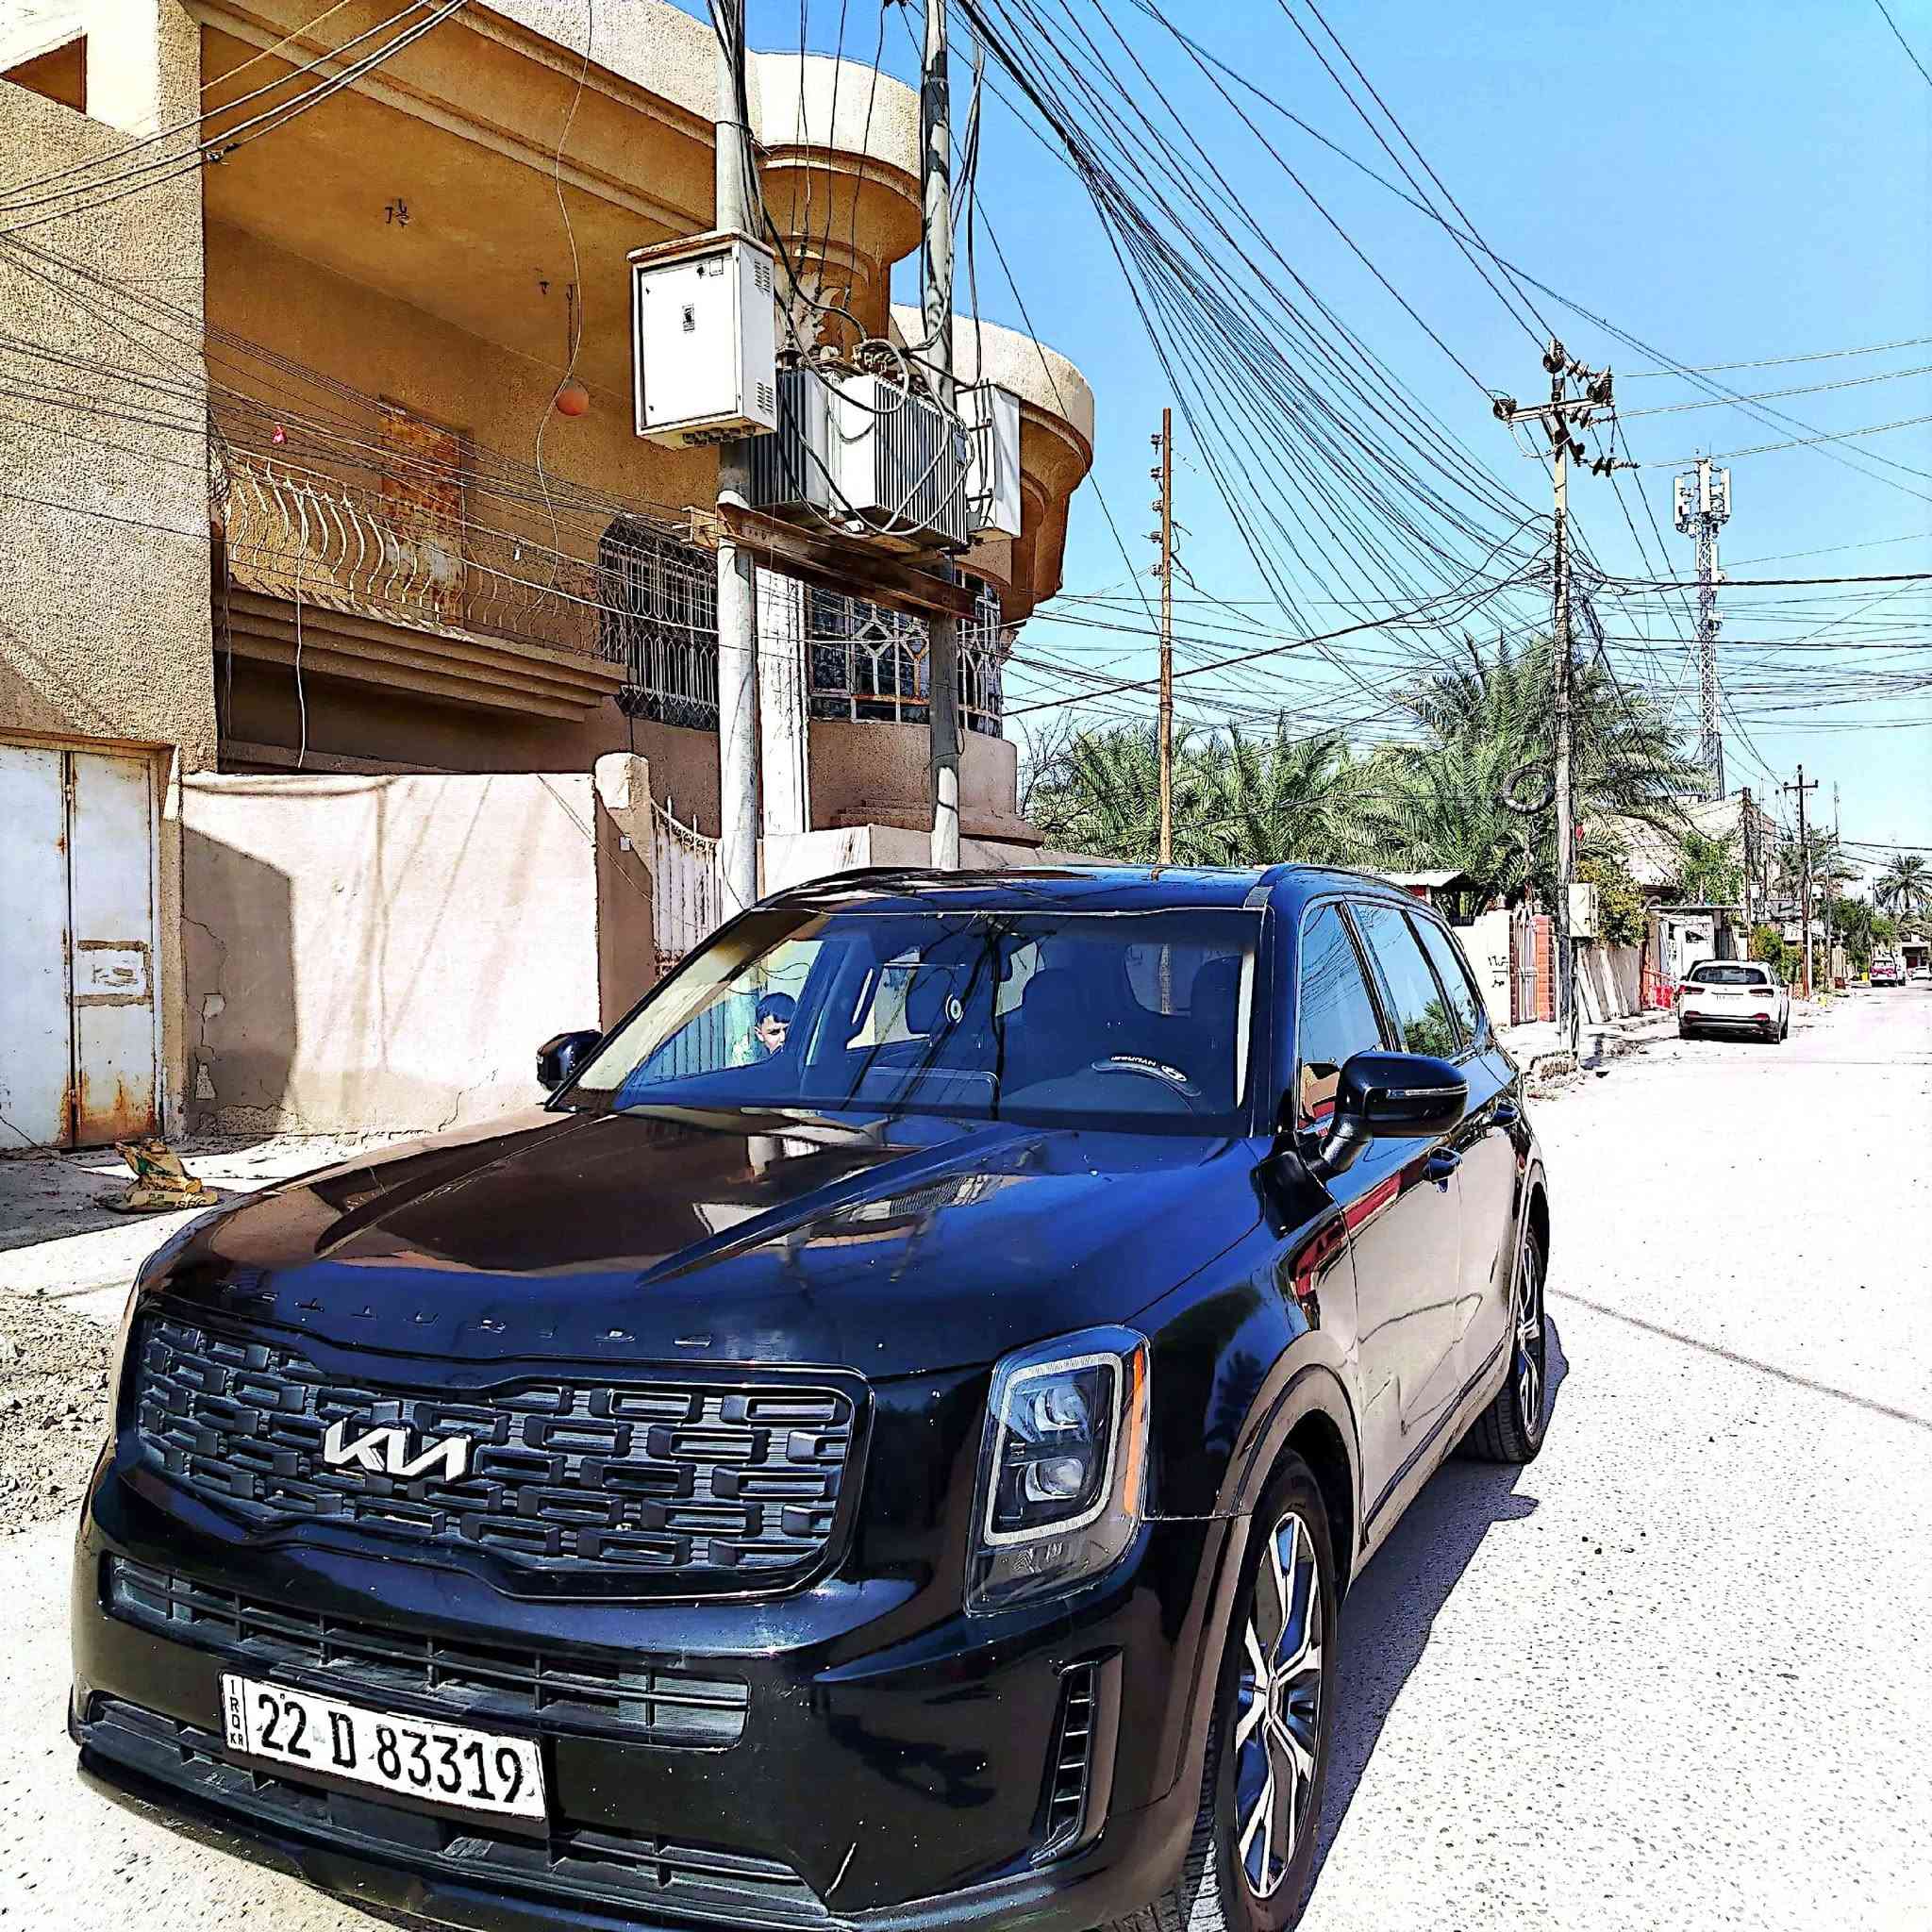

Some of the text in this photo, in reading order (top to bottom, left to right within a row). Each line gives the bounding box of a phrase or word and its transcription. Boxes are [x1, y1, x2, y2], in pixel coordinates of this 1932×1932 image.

[324, 1417, 472, 1482] KIA
[258, 1693, 525, 1805] 22 D 83319
